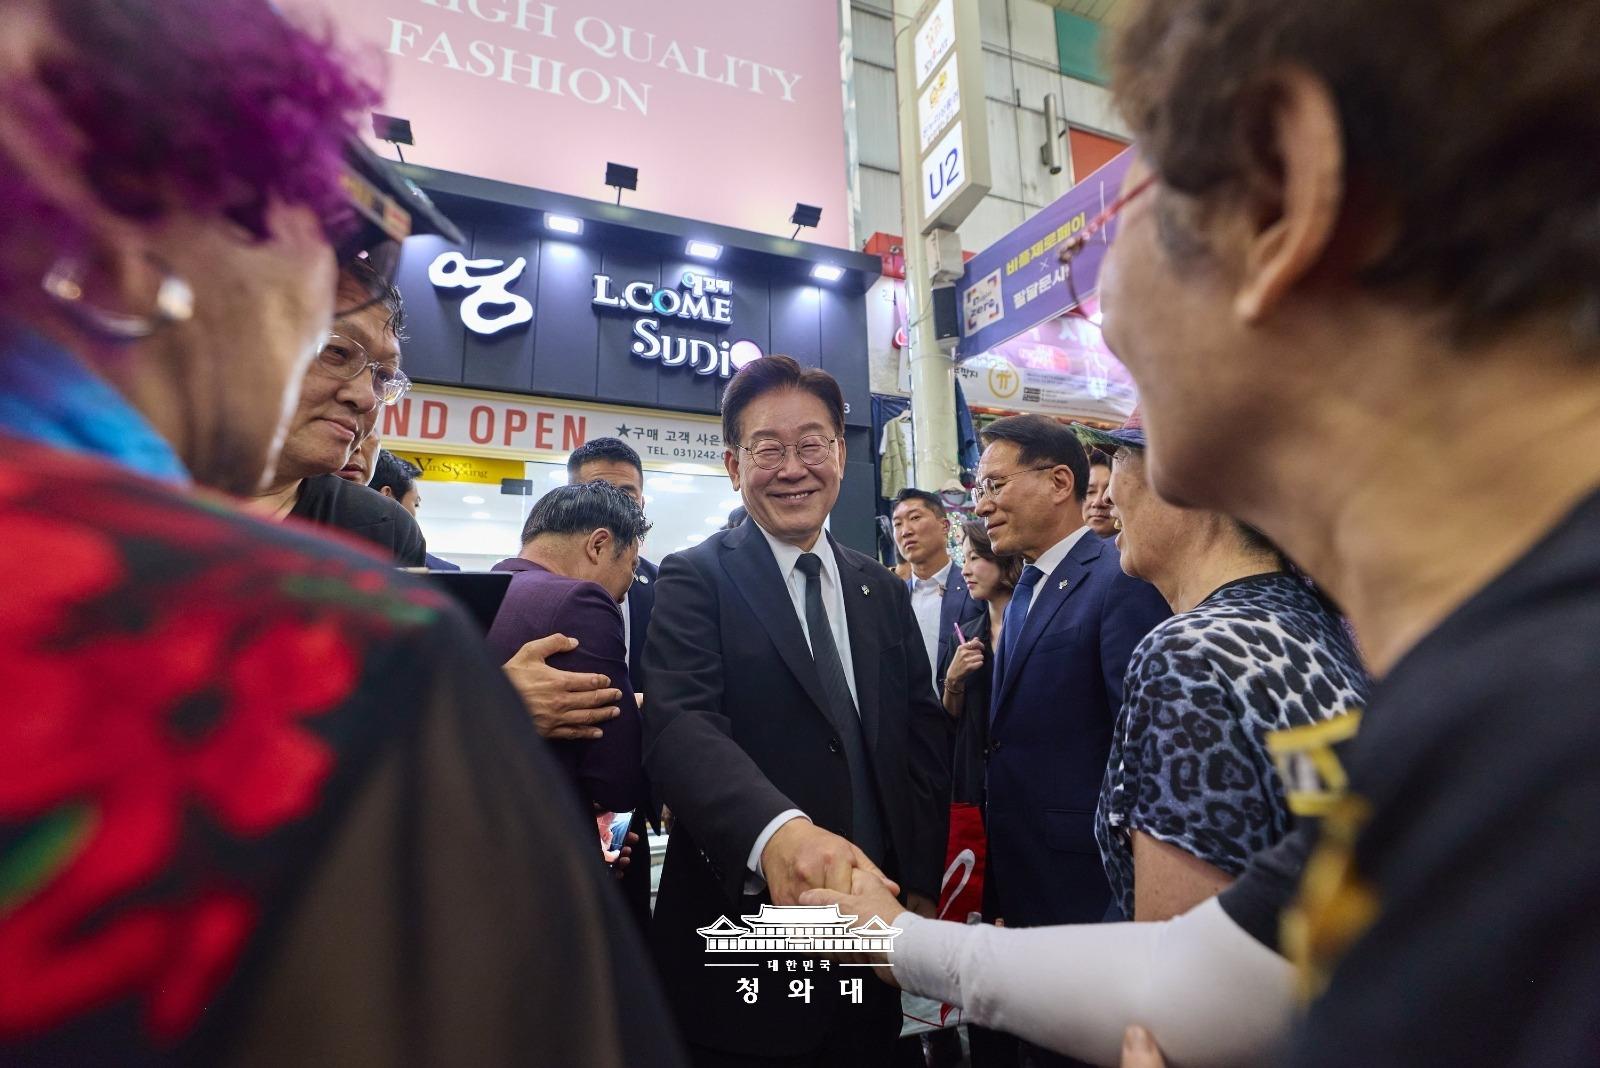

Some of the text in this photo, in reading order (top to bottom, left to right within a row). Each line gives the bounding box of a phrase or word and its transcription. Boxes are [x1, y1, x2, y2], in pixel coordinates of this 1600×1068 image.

[384, 17, 653, 116] FASHION
[420, 0, 802, 102] GH QUALITY
[929, 148, 960, 200] U2
[469, 405, 586, 450] OPEN
[633, 427, 658, 441] 구매
[665, 430, 690, 444] 고객
[647, 446, 669, 456] TEL.
